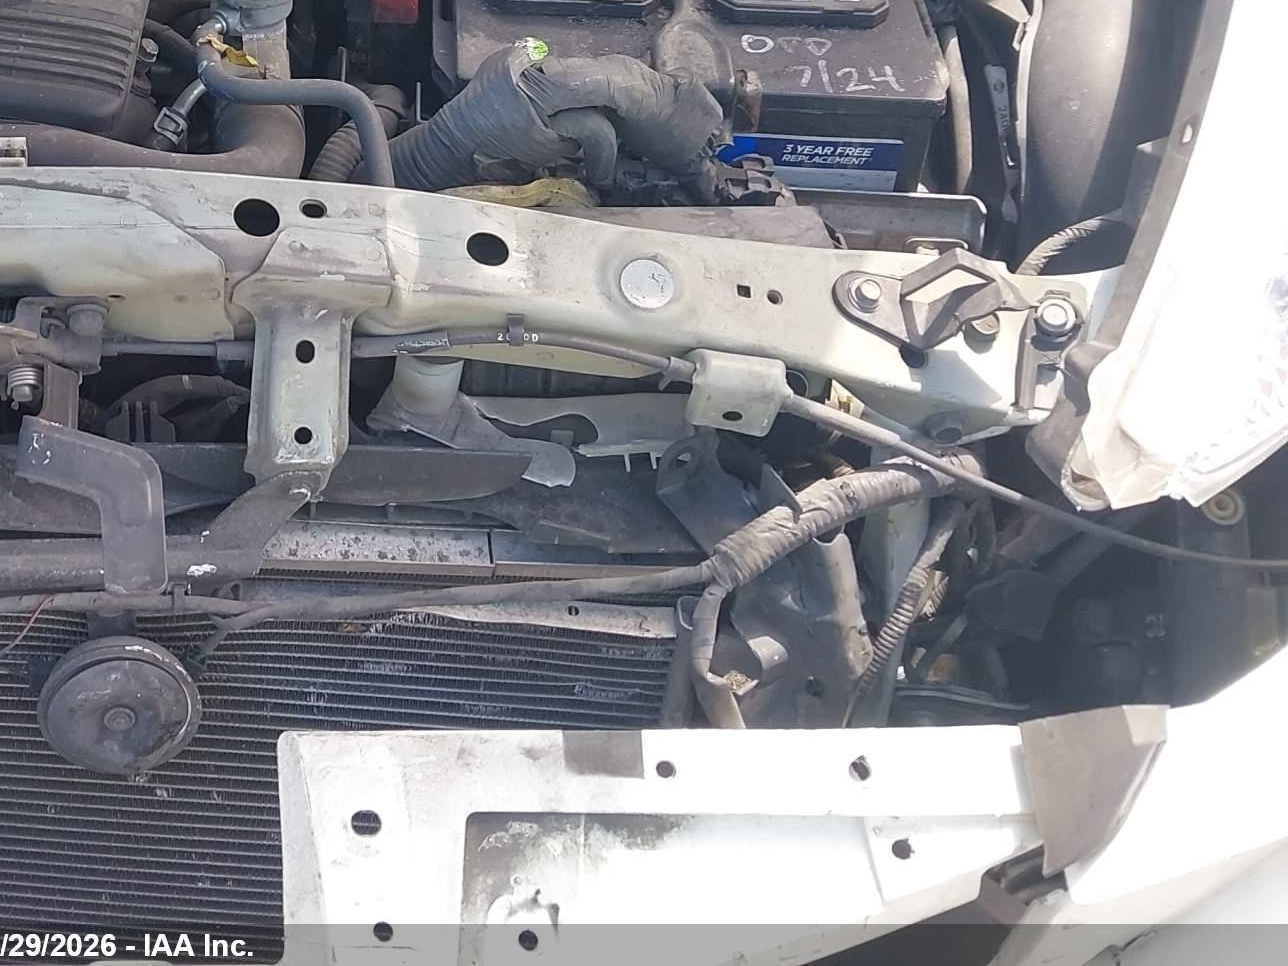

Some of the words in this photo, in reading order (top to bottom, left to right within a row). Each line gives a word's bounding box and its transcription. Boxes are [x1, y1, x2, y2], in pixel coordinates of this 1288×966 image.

[783, 59, 906, 93] 7/24
[783, 144, 794, 153] 3
[795, 145, 833, 155] YEAR
[834, 146, 875, 157] FREE
[781, 154, 868, 165] REPLACEMENT
